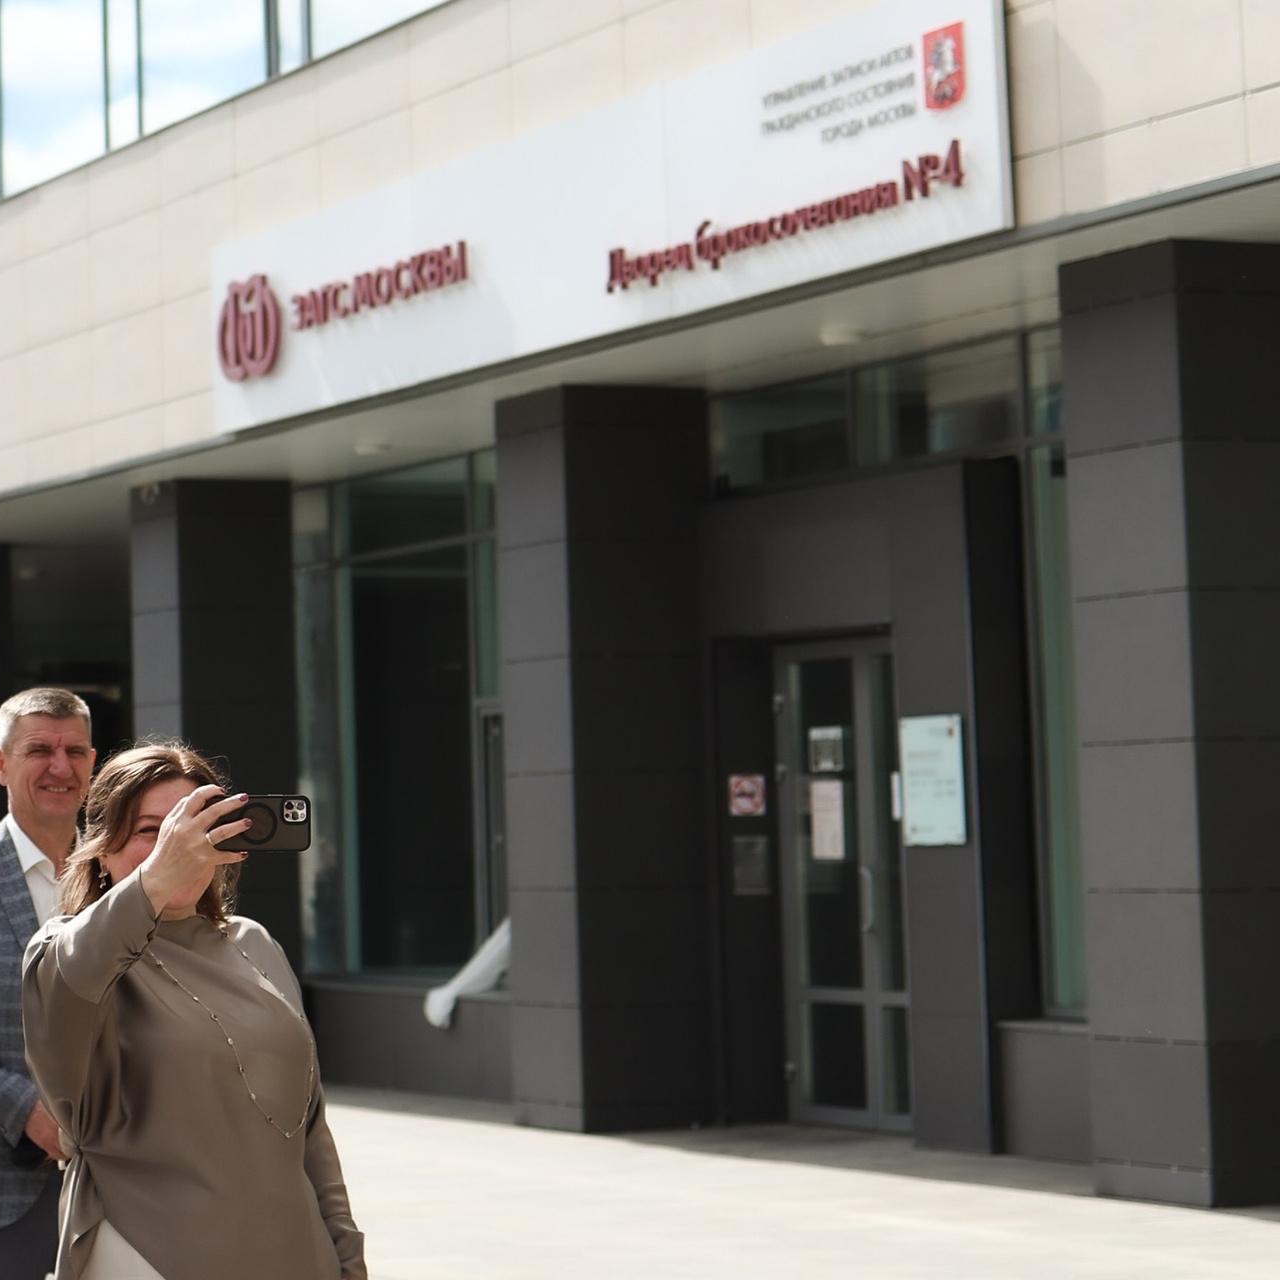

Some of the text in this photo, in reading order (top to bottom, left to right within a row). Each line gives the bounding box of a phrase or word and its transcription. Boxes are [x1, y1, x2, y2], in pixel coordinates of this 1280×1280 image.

[291, 240, 468, 331] ЗАГС МОСКВЫ
[607, 242, 695, 293] Дворец
[695, 180, 899, 270] бракосочетания
